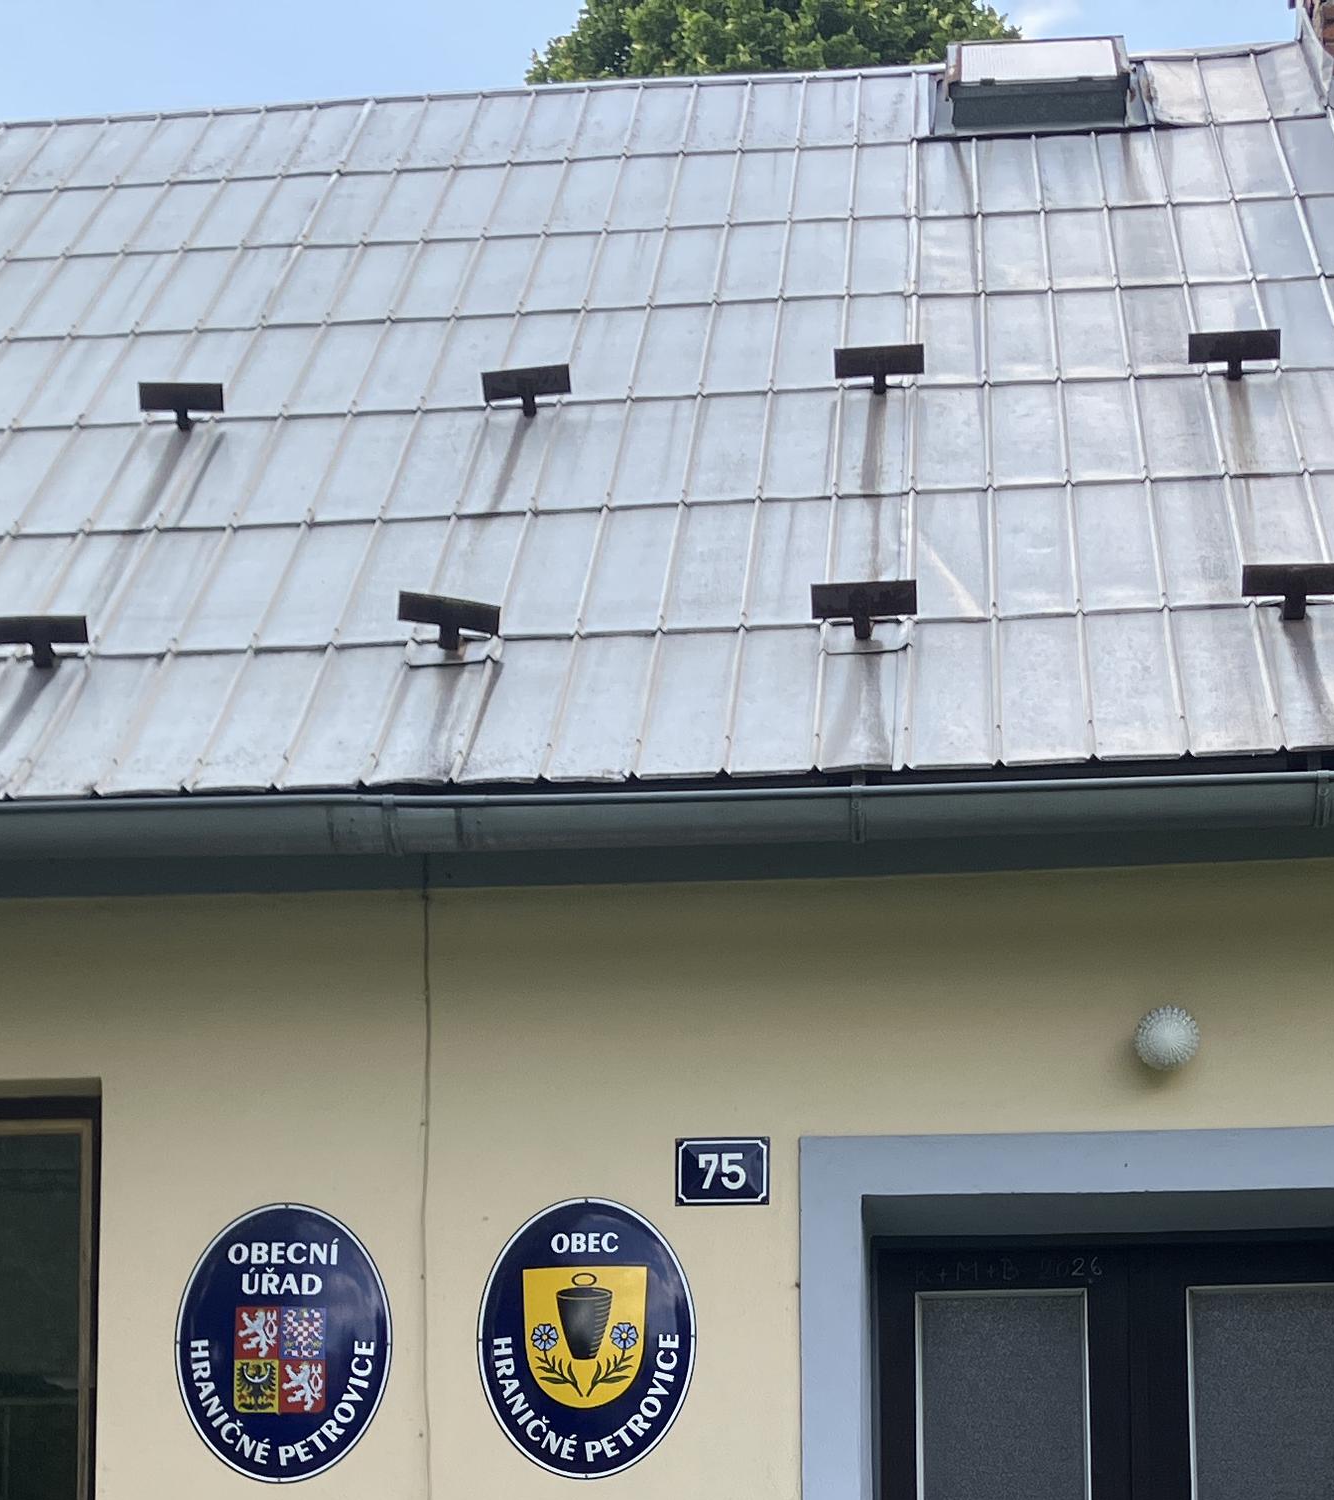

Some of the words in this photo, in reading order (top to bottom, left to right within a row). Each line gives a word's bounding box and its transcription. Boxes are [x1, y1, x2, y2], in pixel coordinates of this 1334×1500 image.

[698, 1152, 747, 1191] 75
[227, 1238, 340, 1265] OBECNÍ
[550, 1232, 619, 1254] OBEC
[241, 1266, 323, 1296] ÚŘAD
[190, 1338, 271, 1466] HRANIČNÉ
[278, 1339, 375, 1467] PETROVICE
[492, 1336, 578, 1461] HRANIČNÉ
[585, 1333, 680, 1462] PETROVICE
